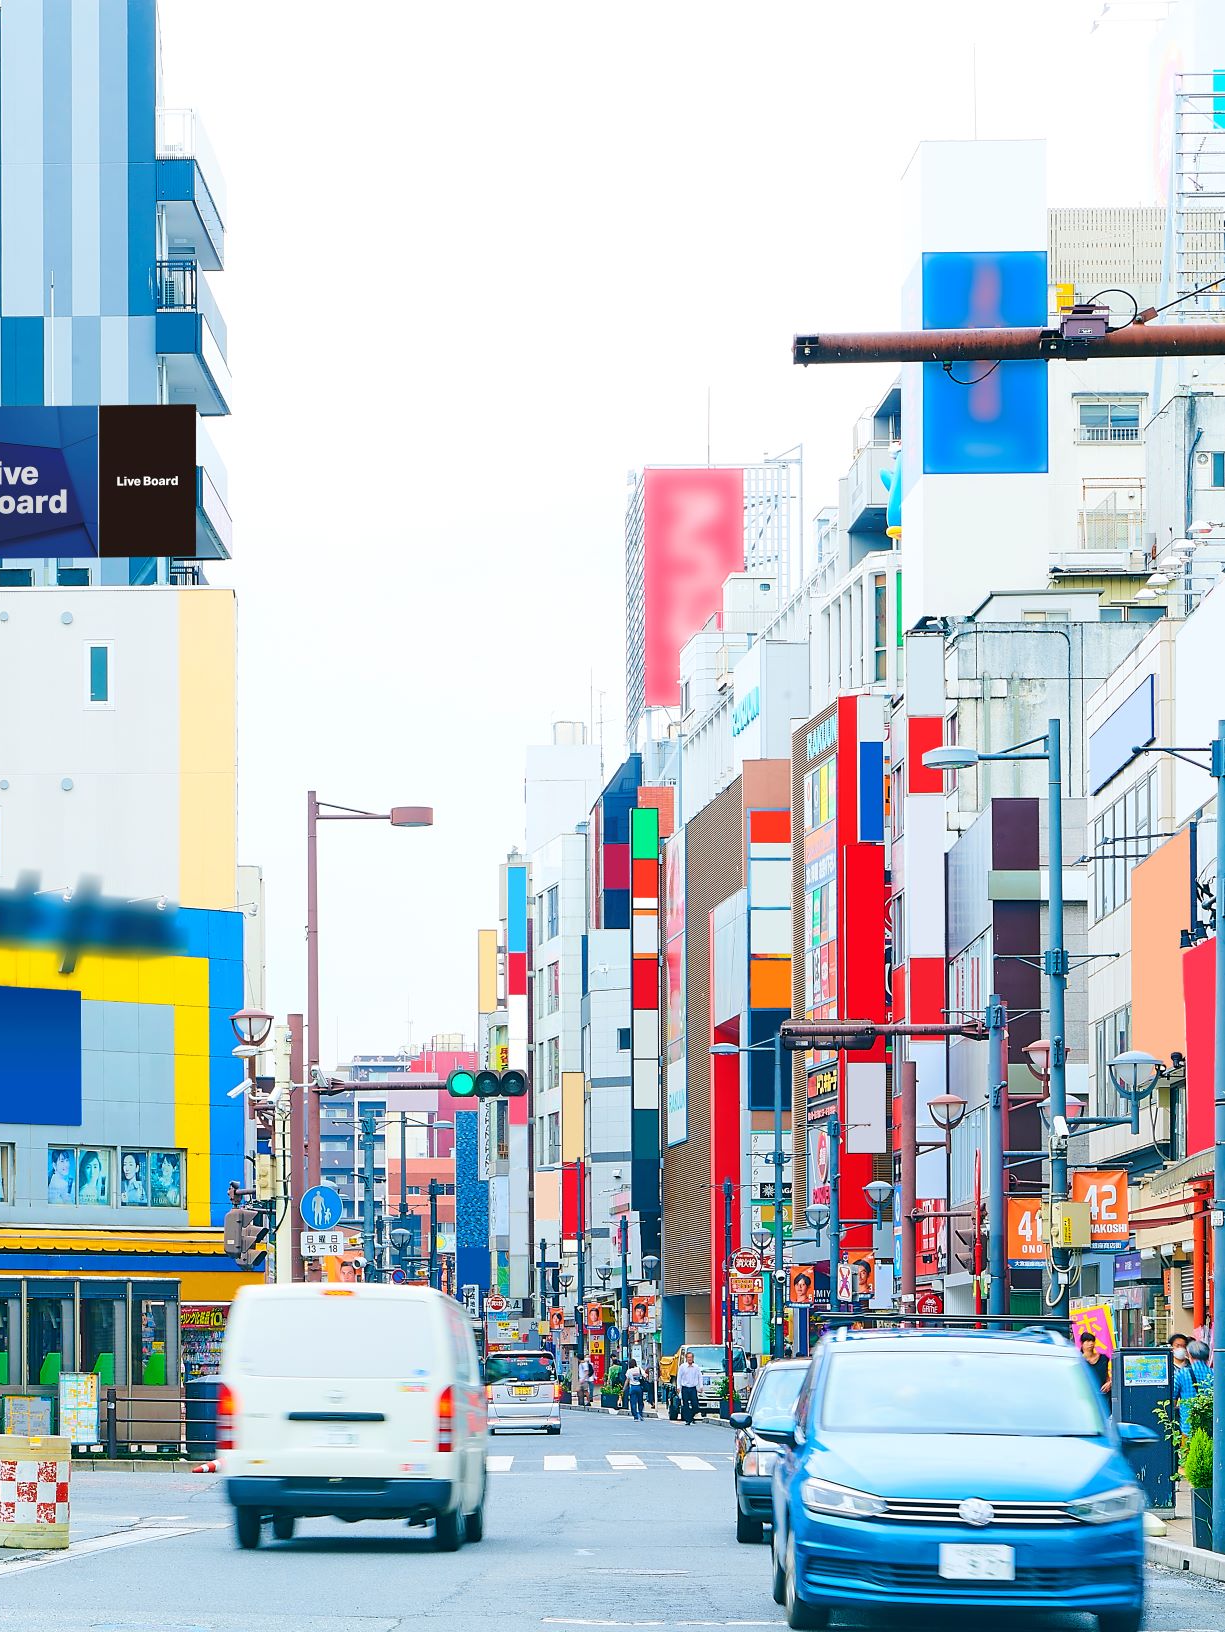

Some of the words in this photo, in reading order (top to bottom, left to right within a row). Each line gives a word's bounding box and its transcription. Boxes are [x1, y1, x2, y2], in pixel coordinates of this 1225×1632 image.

[117, 477, 141, 486] Live
[143, 476, 179, 486] Board
[1084, 1184, 1117, 1220] 42
[1017, 1210, 1043, 1242] 41
[1021, 1244, 1043, 1254] ONO
